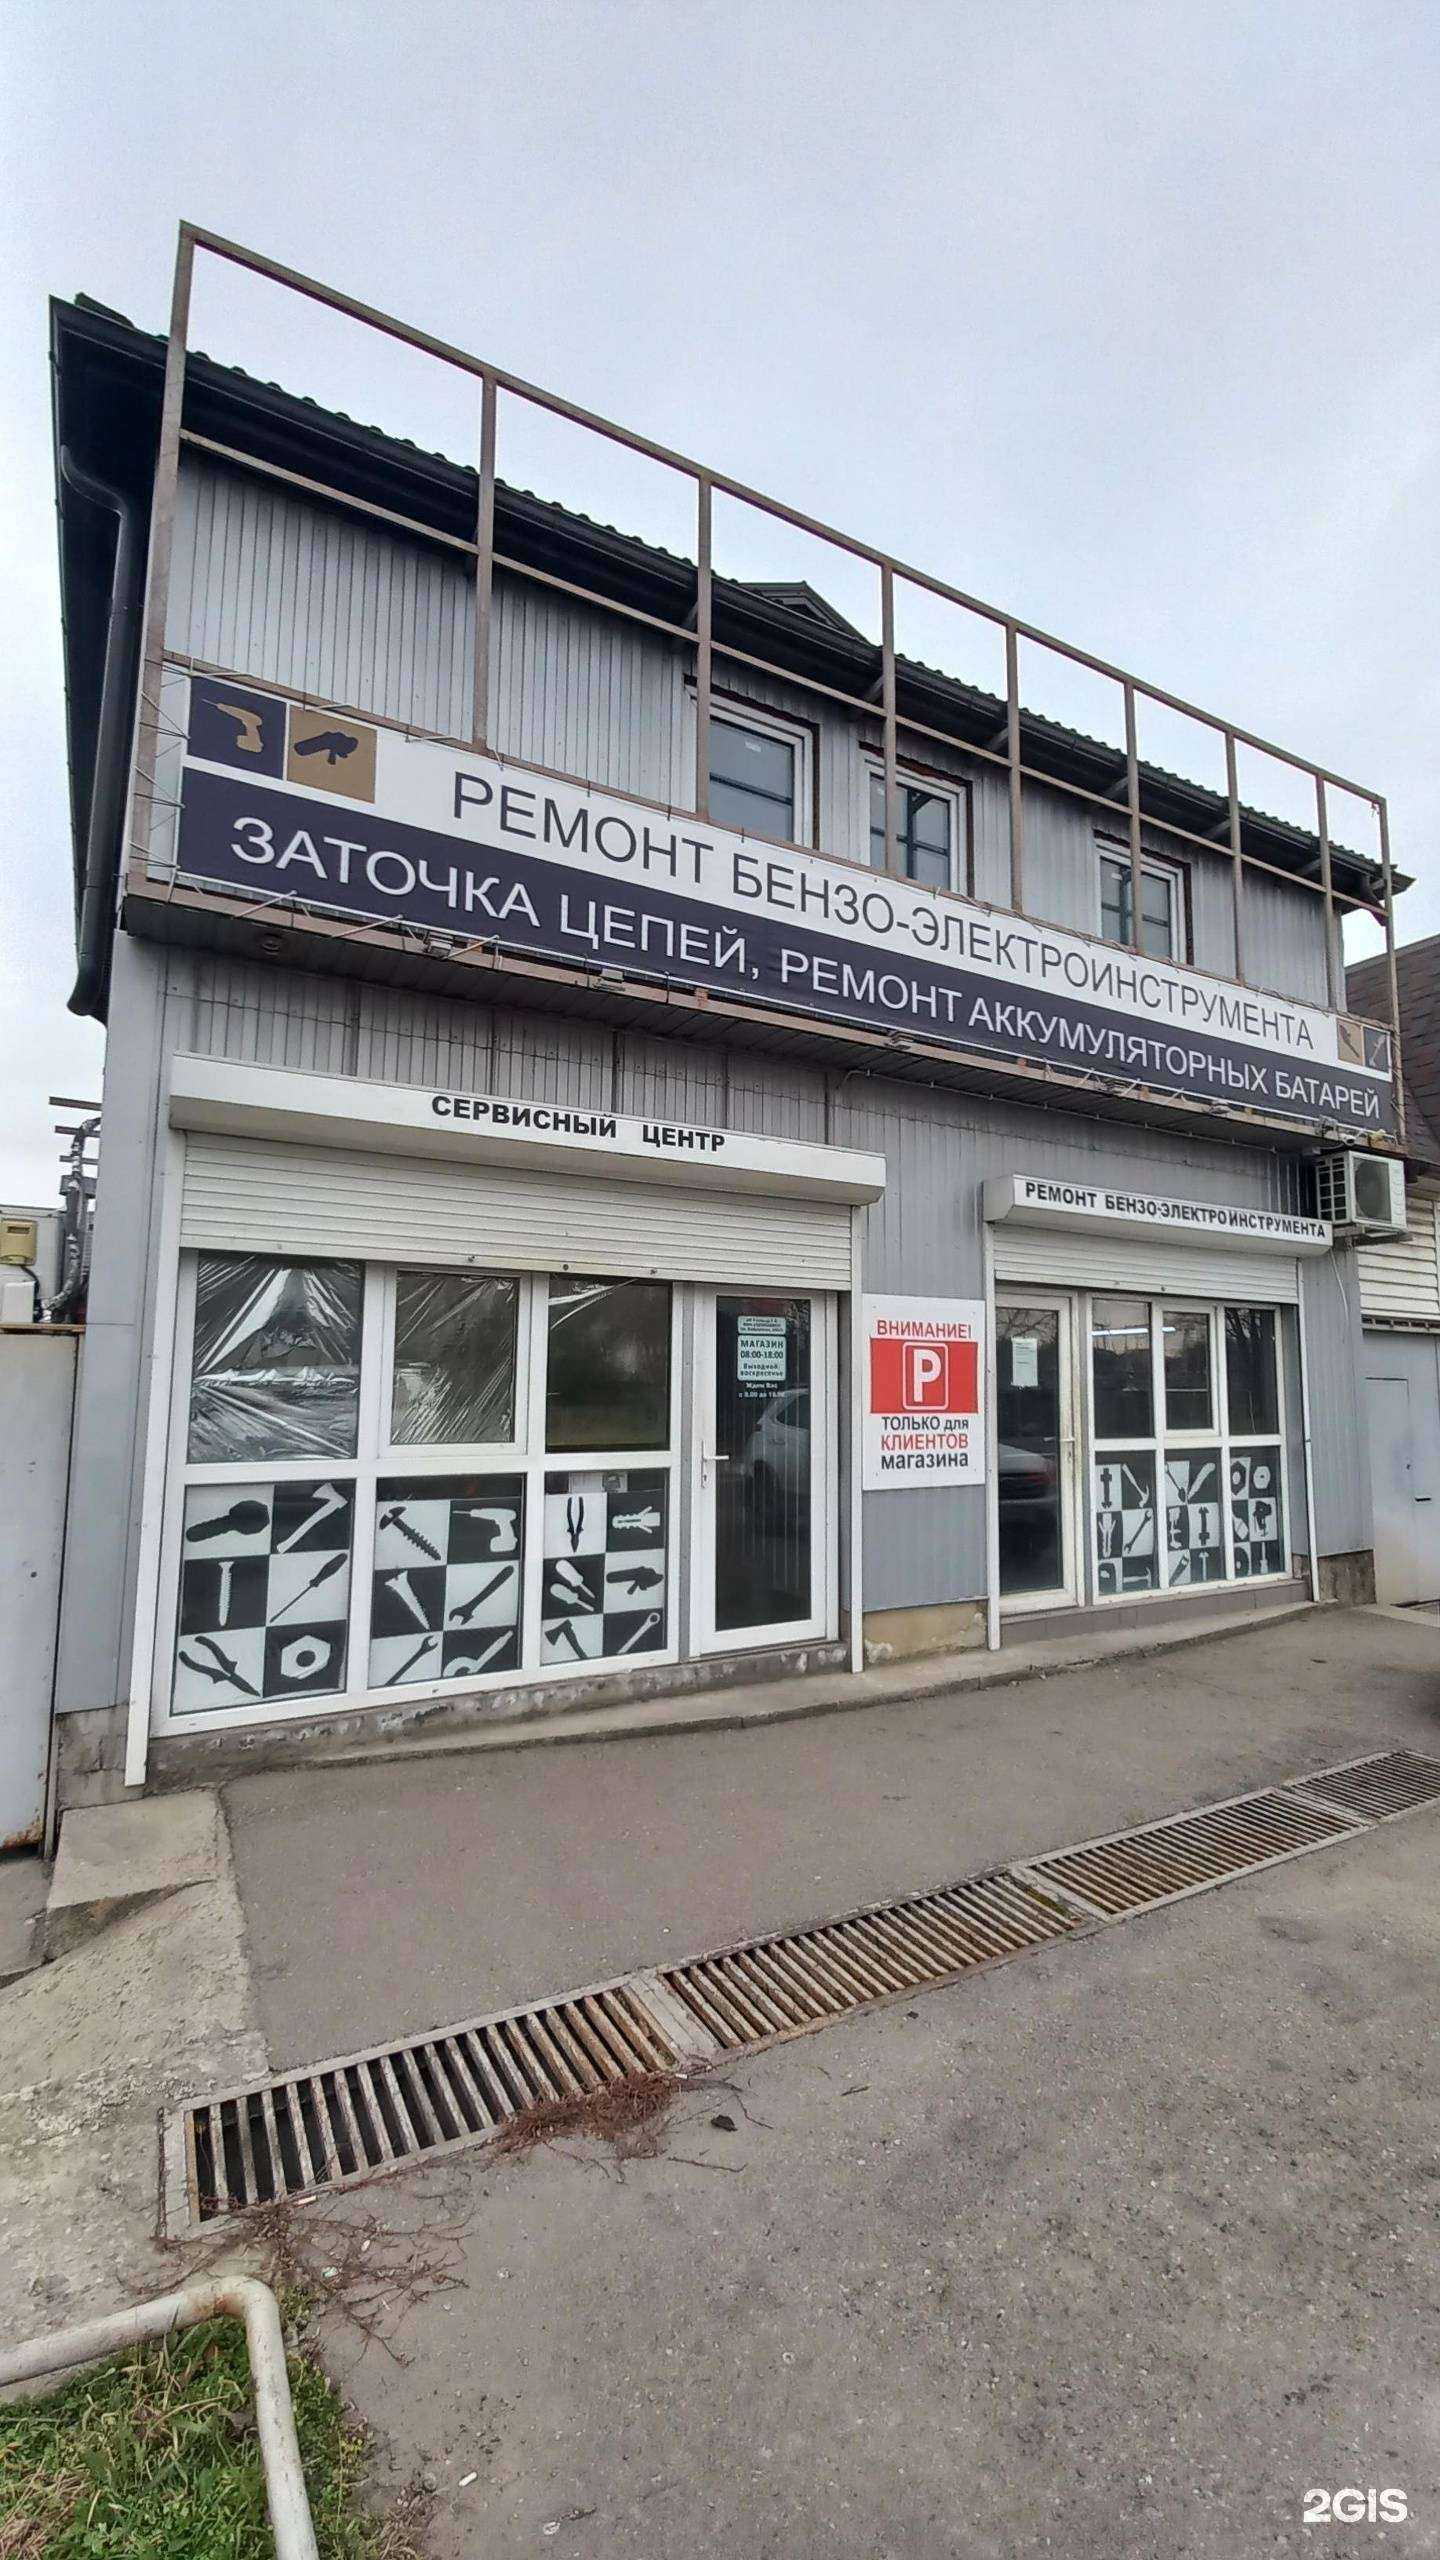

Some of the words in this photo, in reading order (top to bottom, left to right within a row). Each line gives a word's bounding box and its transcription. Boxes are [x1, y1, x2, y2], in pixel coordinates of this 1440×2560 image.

[451, 770, 714, 884] РЕМОНТ
[731, 852, 1314, 1051] БЕНЗО-ЭЛЕКТРОИНСТРУМЕНТА
[230, 816, 540, 928] ЗАТОЧКА
[559, 892, 760, 981] ЦЕПЕЙ,
[780, 948, 962, 1024] РЕМОНТ
[968, 996, 1269, 1095] АККУМУЛЯТОРНЫХ
[1275, 1070, 1380, 1120] БАТАРЕЙ
[431, 1095, 617, 1139] СЕРВИСНЫЙ
[642, 1124, 726, 1152] ЦЕНТР
[1025, 1181, 1098, 1208] РЕМОНТ
[1105, 1194, 1326, 1239] БЕНЗО-ЭЛЕКТРОИНСТРУМЕНТА
[876, 1319, 972, 1339] ВНИМАНИЕ!
[740, 1340, 783, 1348] МАГАЗИН
[882, 1416, 941, 1431] ТОЛЬКО
[944, 1418, 969, 1432] для
[881, 1433, 969, 1451] КЛИЕНТОВ
[881, 1452, 969, 1470] магазина
